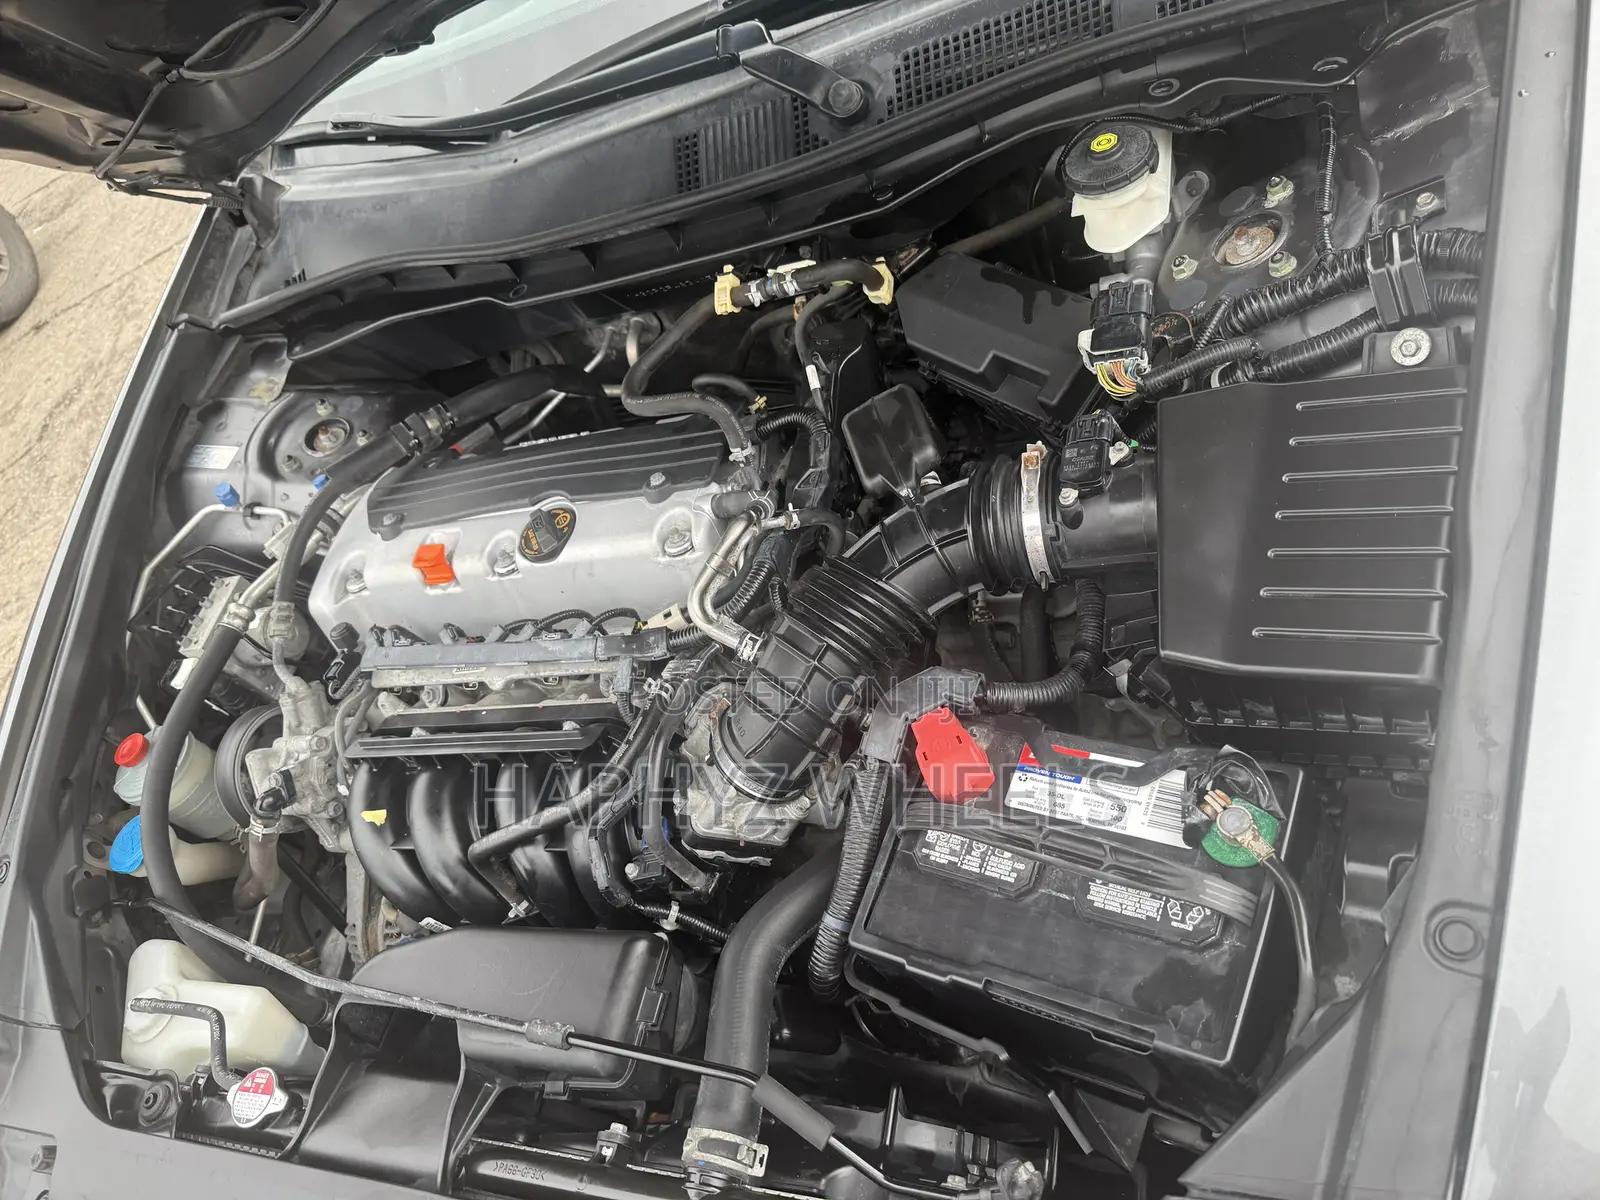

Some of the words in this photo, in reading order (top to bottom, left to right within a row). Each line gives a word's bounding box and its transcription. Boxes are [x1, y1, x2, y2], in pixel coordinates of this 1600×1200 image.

[1023, 765, 1050, 775] PROVEN
[1051, 771, 1075, 781] TOUGH
[1017, 800, 1042, 810] DISTRIBUTED
[1109, 802, 1127, 813] 550
[1110, 814, 1123, 822] 100
[1012, 861, 1025, 869] ACID
